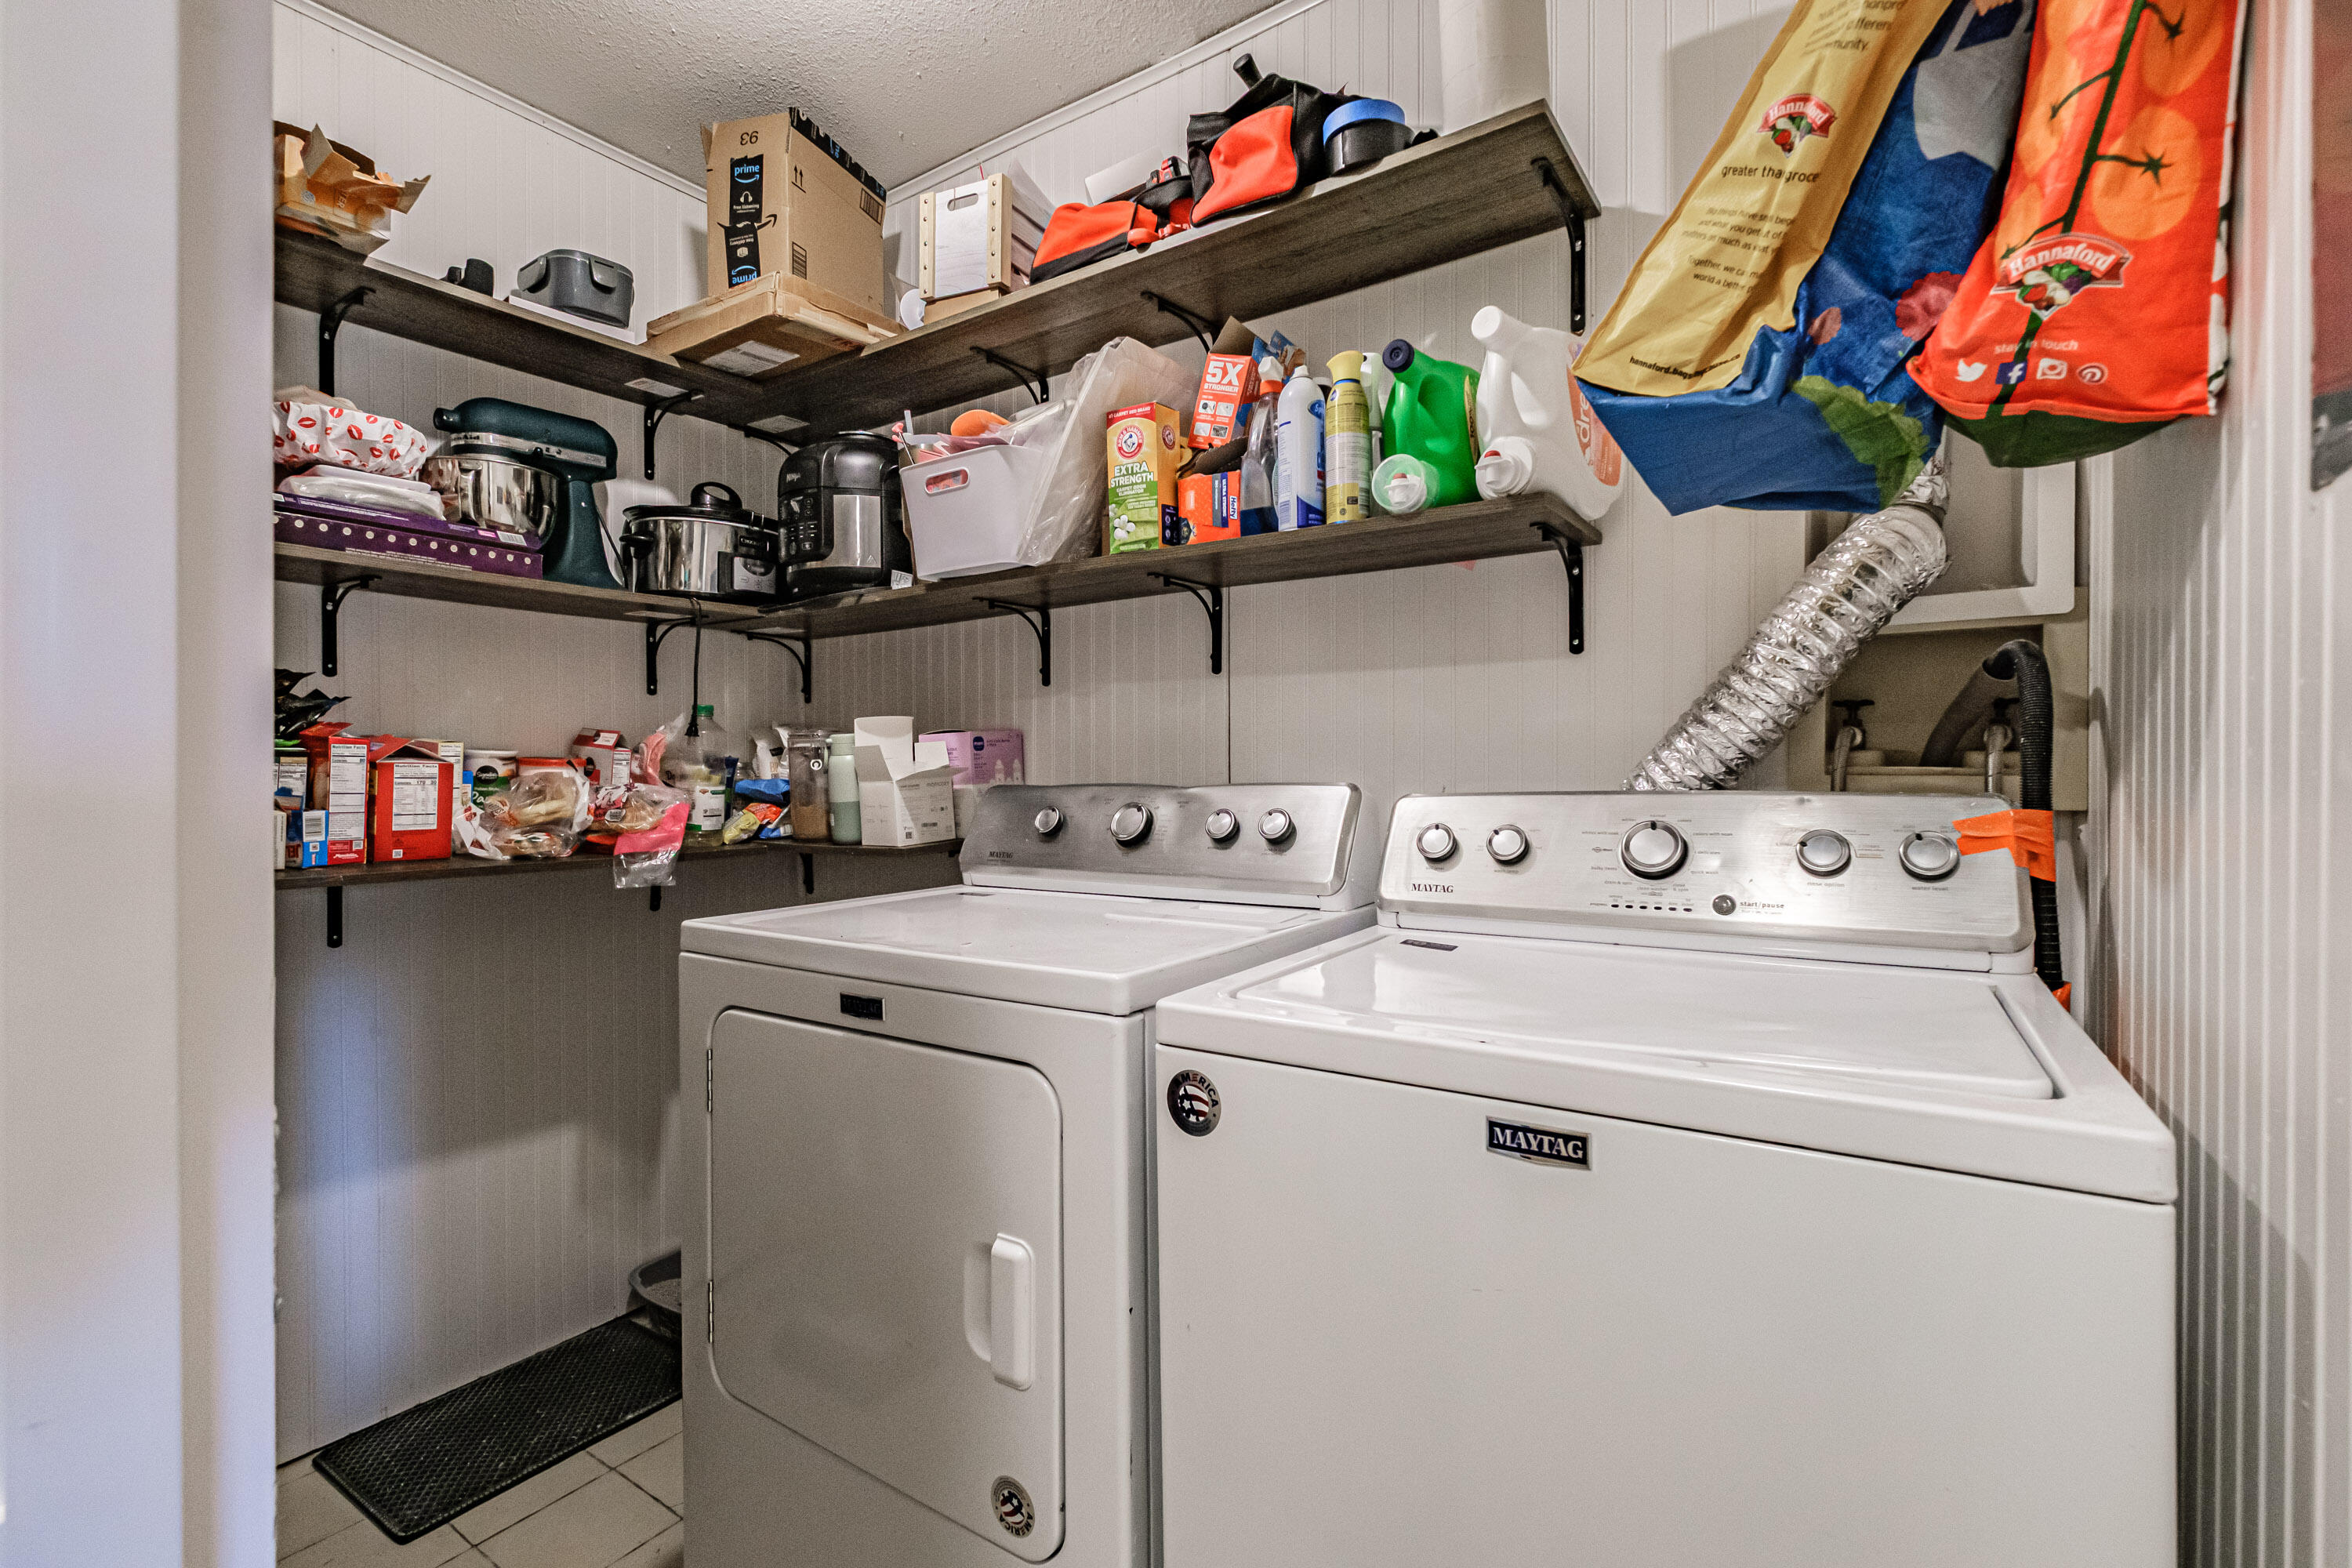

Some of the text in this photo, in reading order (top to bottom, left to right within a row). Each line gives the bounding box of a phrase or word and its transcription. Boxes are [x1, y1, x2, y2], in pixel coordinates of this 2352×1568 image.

[735, 164, 760, 176] prime
[1722, 165, 1759, 179] greater
[1730, 223, 1746, 233] you
[1747, 227, 1761, 236] get
[1719, 236, 1740, 246] much
[1741, 241, 1751, 250] as
[2009, 242, 2117, 278] Hannaford
[731, 270, 757, 284] prime
[1693, 272, 1715, 284] world
[1722, 278, 1746, 289] bettr
[1994, 339, 2078, 354] stay in touch
[1206, 361, 1244, 386] 5X
[1203, 383, 1240, 393] STRONGER
[1114, 461, 1149, 477] EXTRA
[1110, 472, 1154, 488] STRENGTH
[989, 851, 1013, 859] MAYTAG
[1411, 884, 1454, 894] MAYTAG
[1174, 1072, 1220, 1108] AMERICA
[1493, 1127, 1584, 1159] MAYTAG
[999, 1511, 1033, 1537] AMERICA
